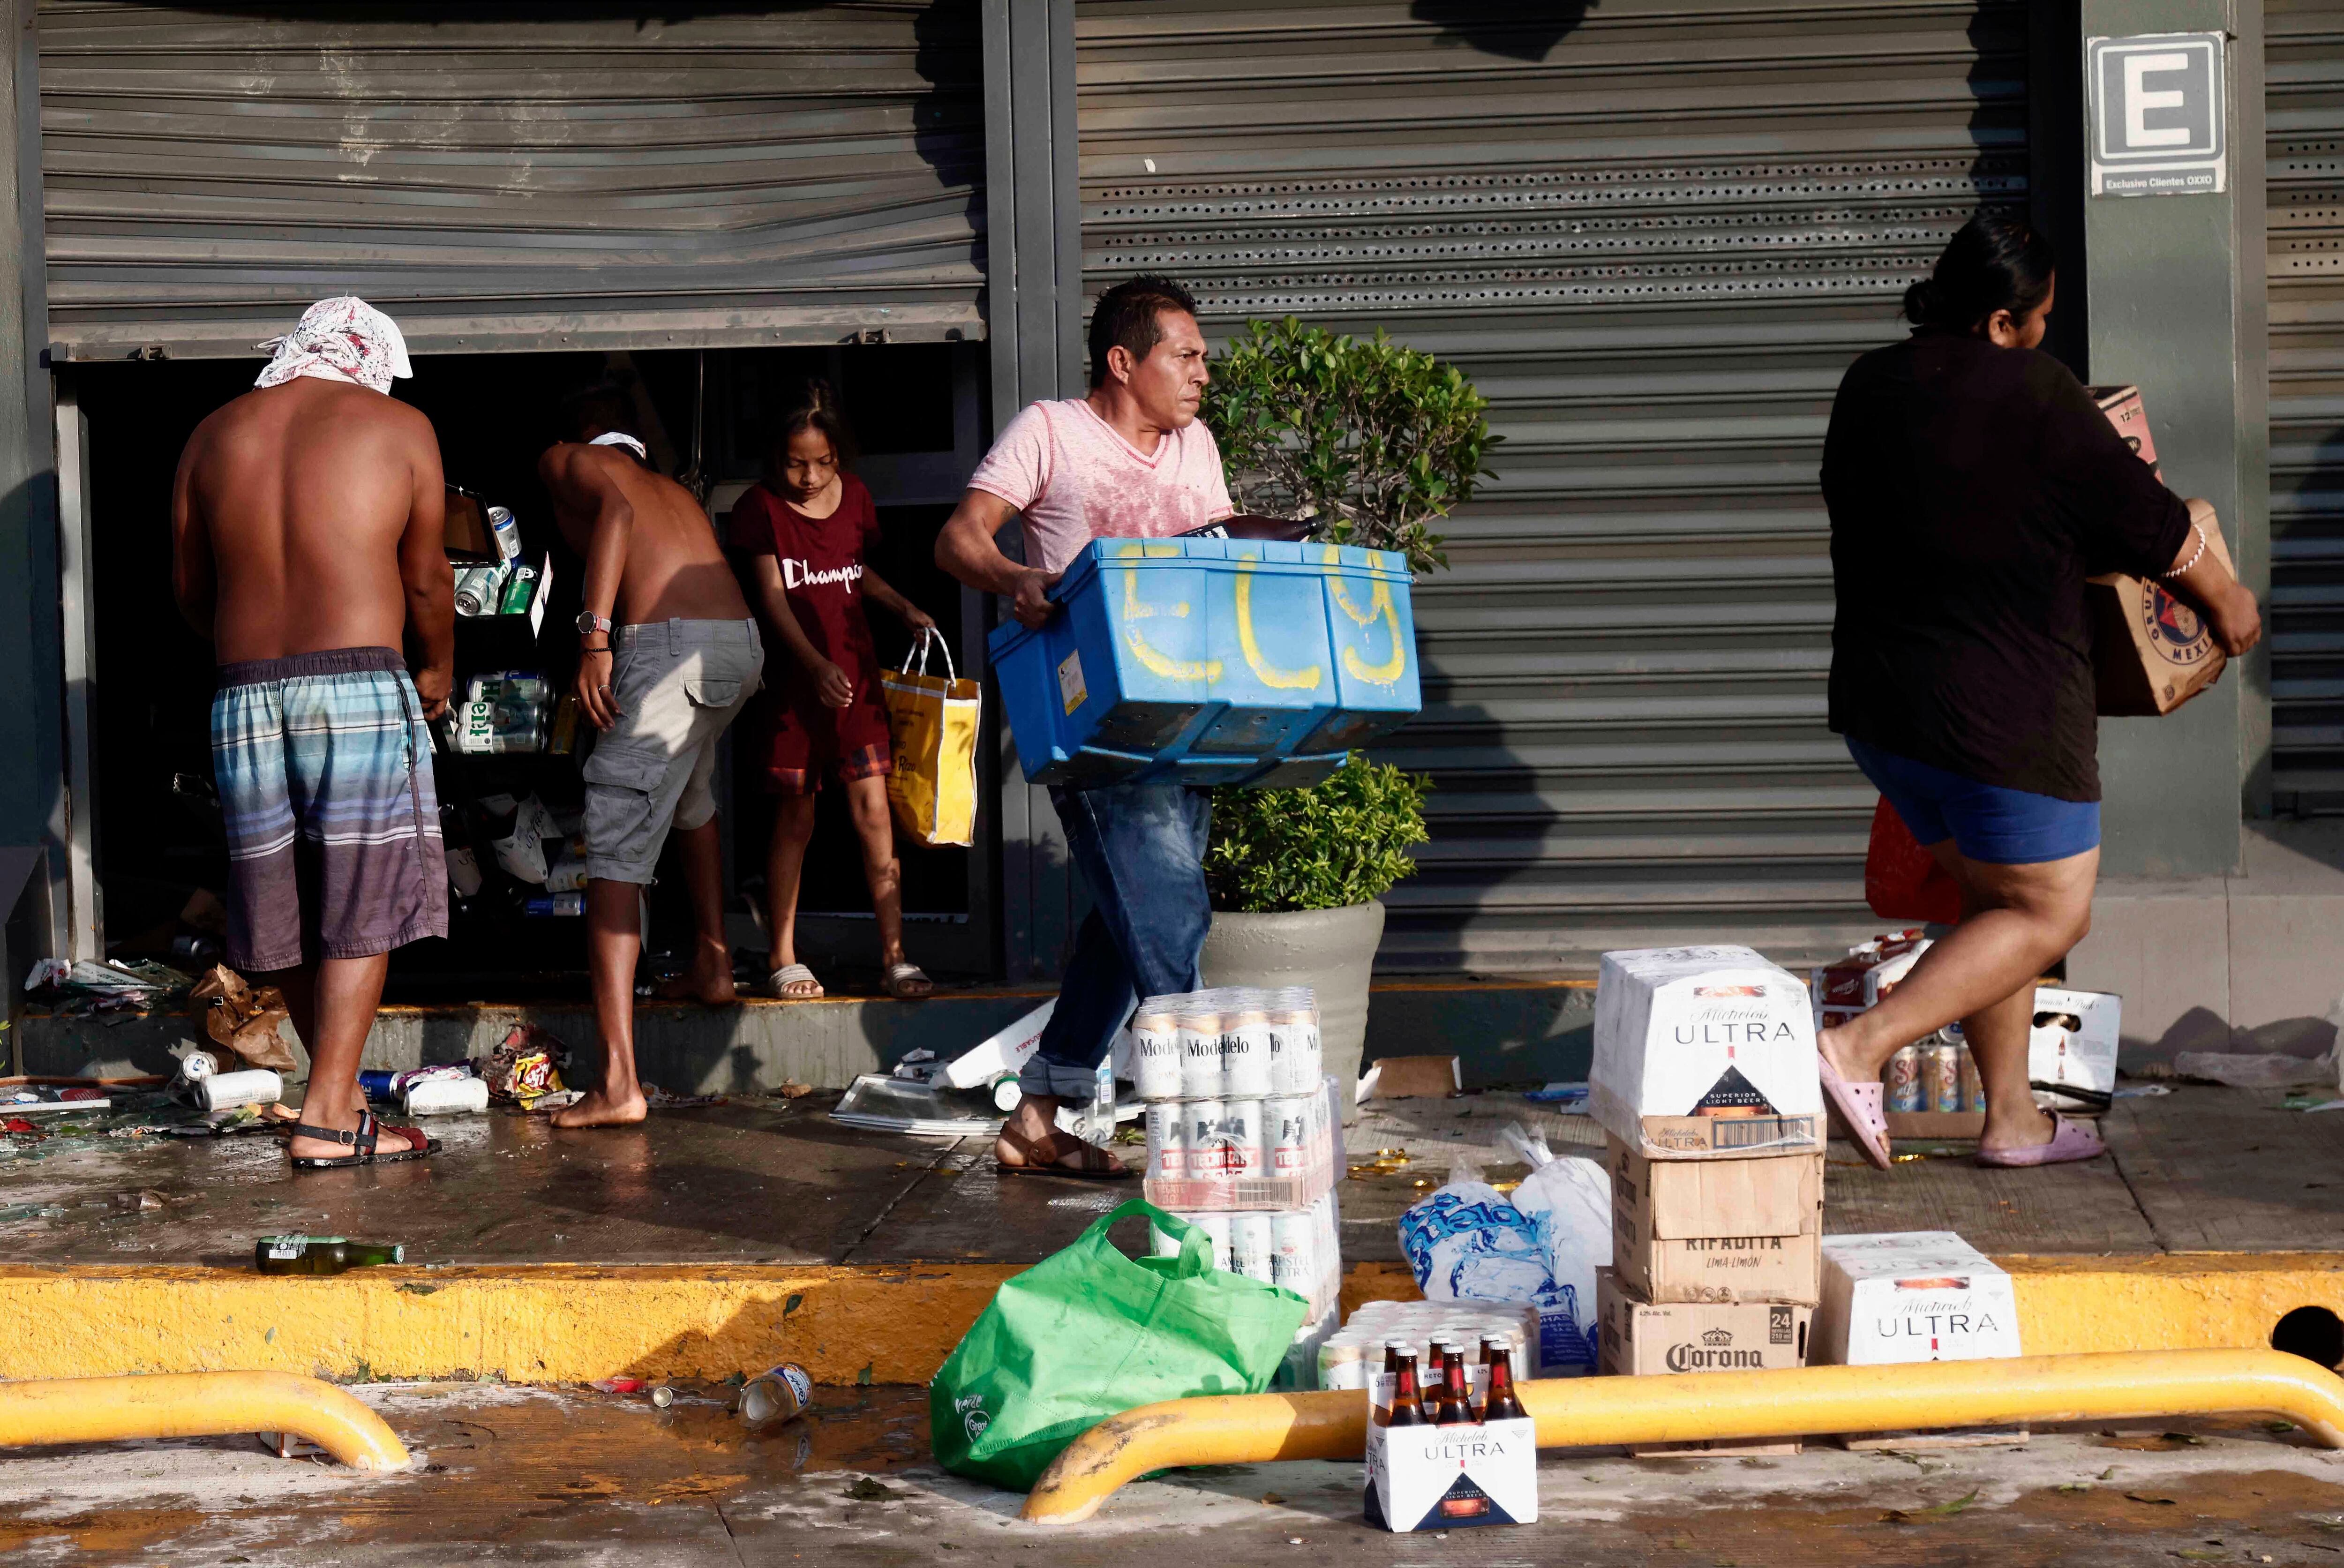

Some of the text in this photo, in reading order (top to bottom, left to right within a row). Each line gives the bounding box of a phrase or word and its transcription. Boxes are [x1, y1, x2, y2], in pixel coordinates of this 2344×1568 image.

[2124, 53, 2190, 147] E
[2149, 177, 2185, 188] Clientes
[2186, 174, 2212, 185] OXXO
[2143, 585, 2160, 640] GRUP
[2173, 638, 2209, 660] MEXI
[1675, 1022, 1795, 1044] ULTRA
[1772, 1313, 1791, 1328] 24
[1877, 1313, 1998, 1337] ULTRA
[1666, 1343, 1764, 1373] Corona
[1425, 1442, 1505, 1460] ULTRA
